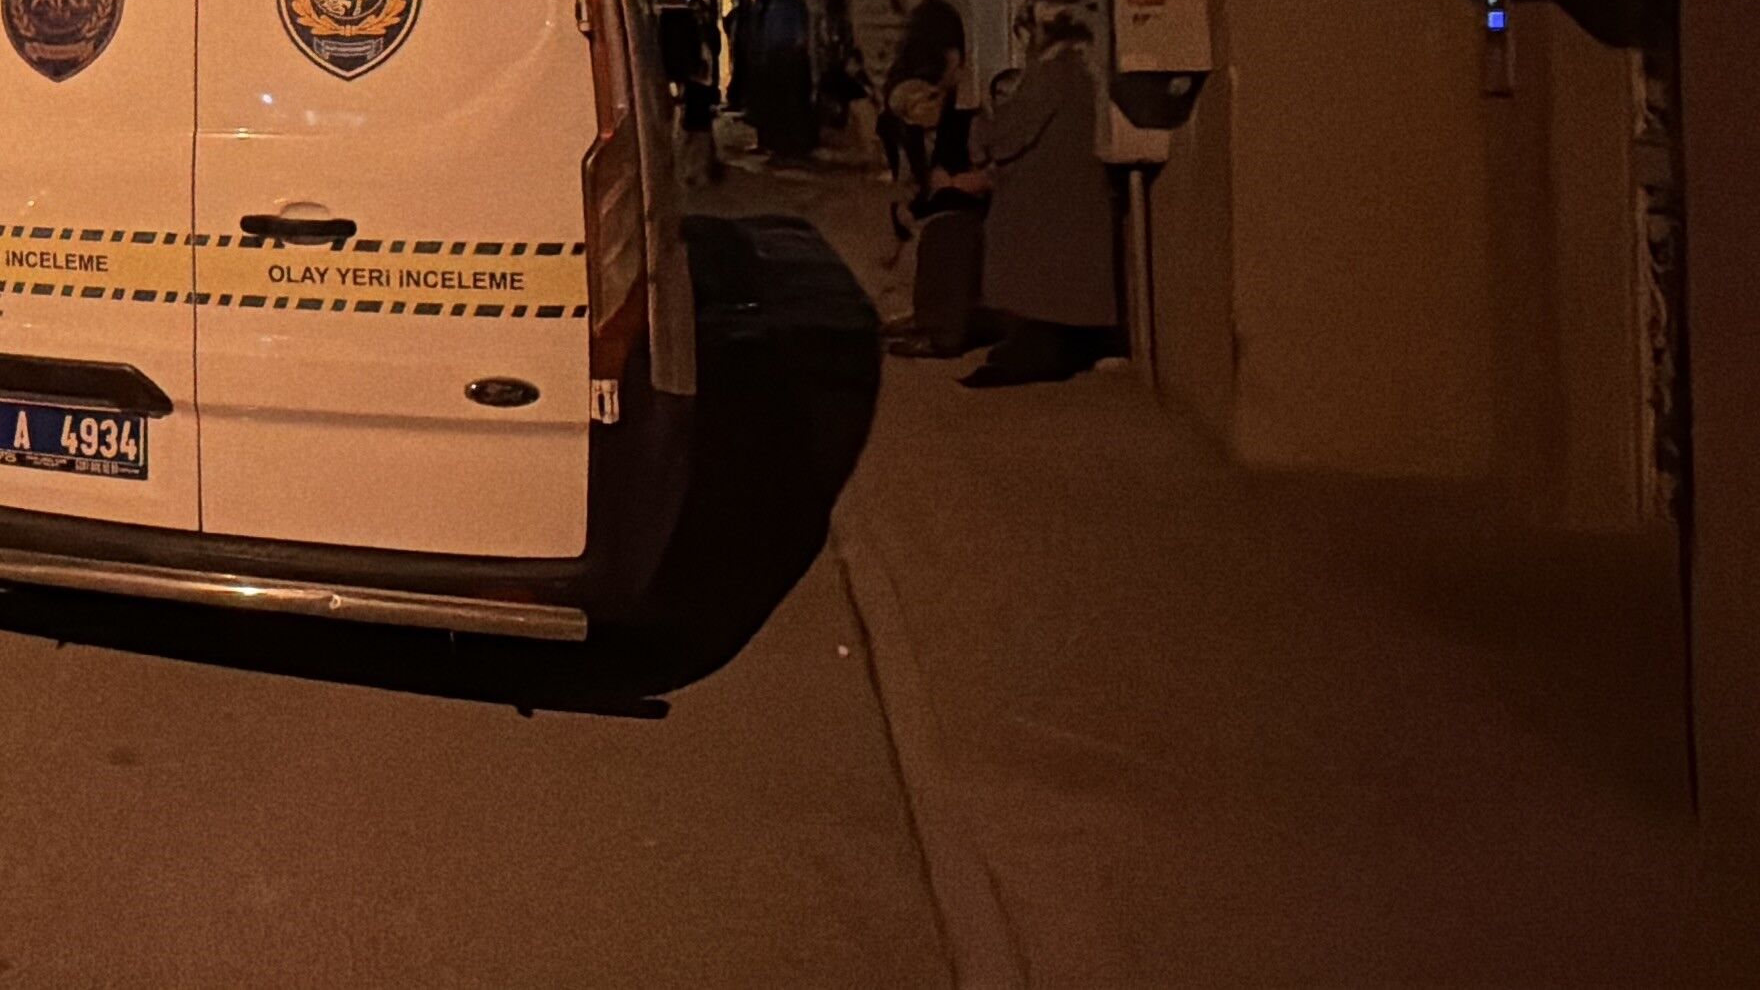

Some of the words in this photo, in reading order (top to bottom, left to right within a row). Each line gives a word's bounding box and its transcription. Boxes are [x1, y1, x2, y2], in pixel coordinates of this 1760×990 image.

[268, 264, 329, 284] OLAY
[13, 410, 30, 450] A
[60, 415, 137, 461] 4934
